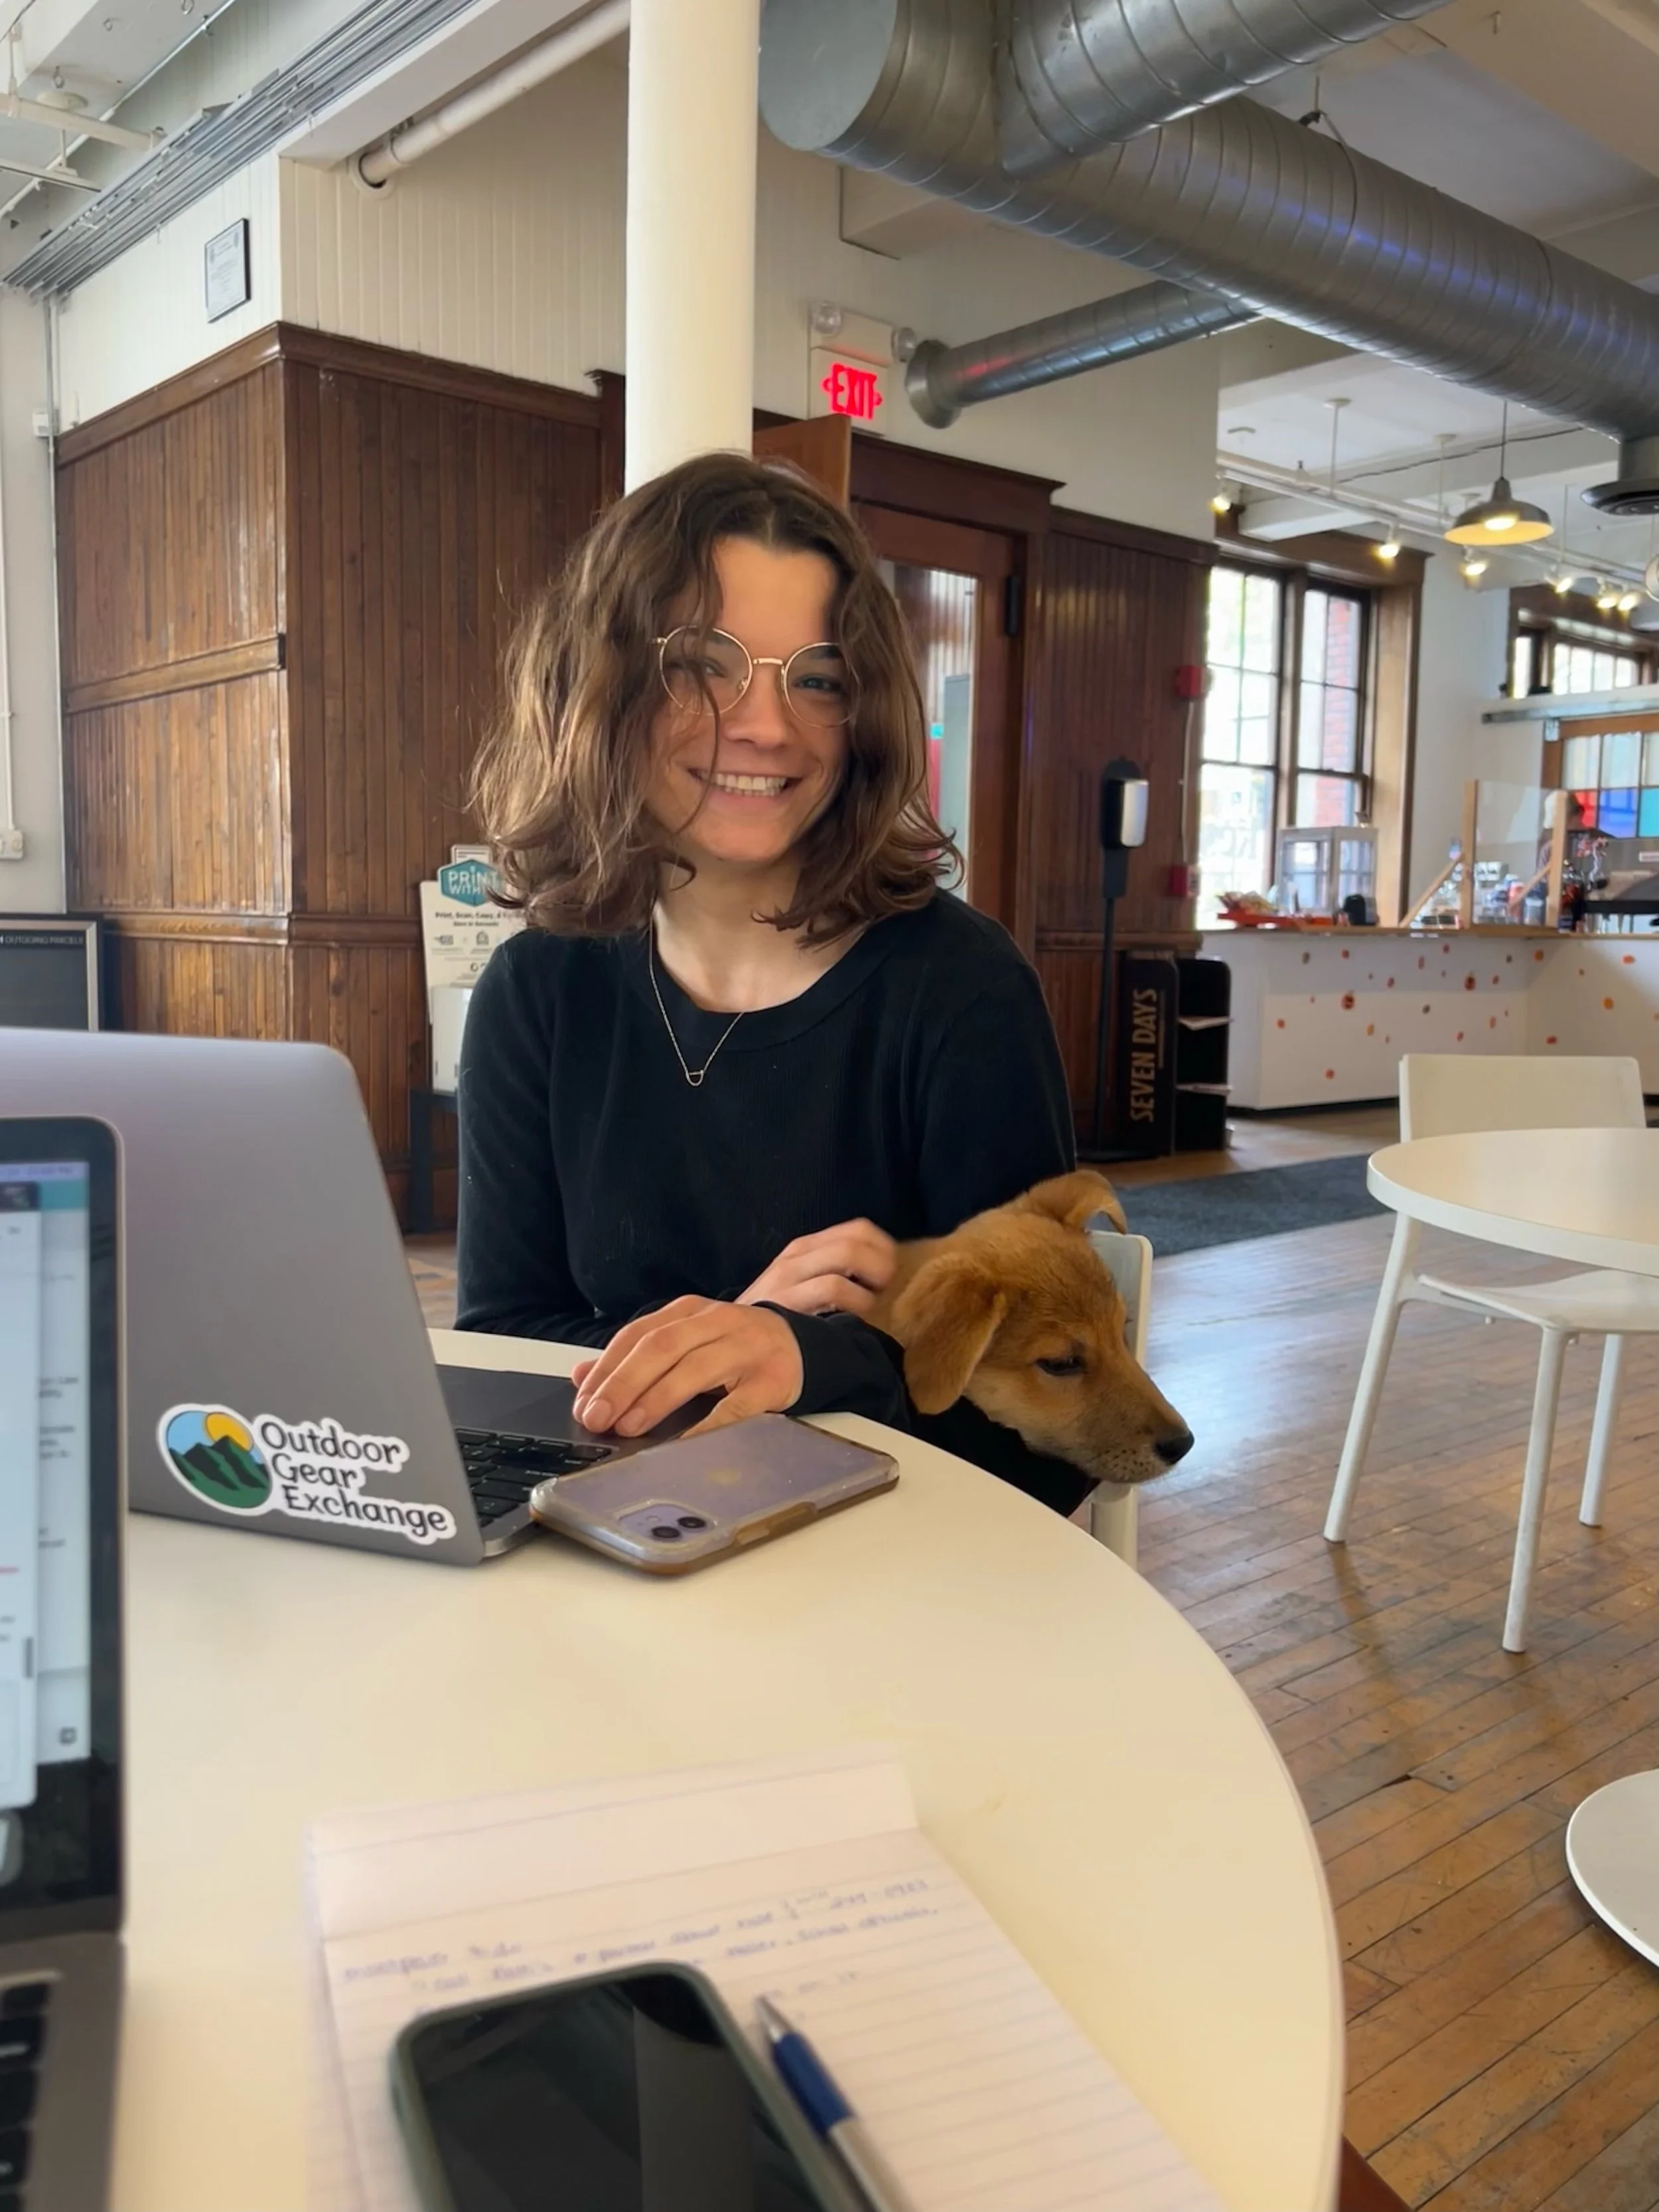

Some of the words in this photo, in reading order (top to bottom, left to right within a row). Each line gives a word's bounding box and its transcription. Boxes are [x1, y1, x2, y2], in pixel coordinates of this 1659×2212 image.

[830, 362, 877, 419] EXIT
[448, 865, 500, 888] PRINT
[1132, 988, 1158, 1045] DAYS
[1130, 1052, 1155, 1122] SEVEN
[261, 1422, 401, 1464] Outdoor
[271, 1453, 358, 1489] Gear
[282, 1484, 449, 1537] Exchange
